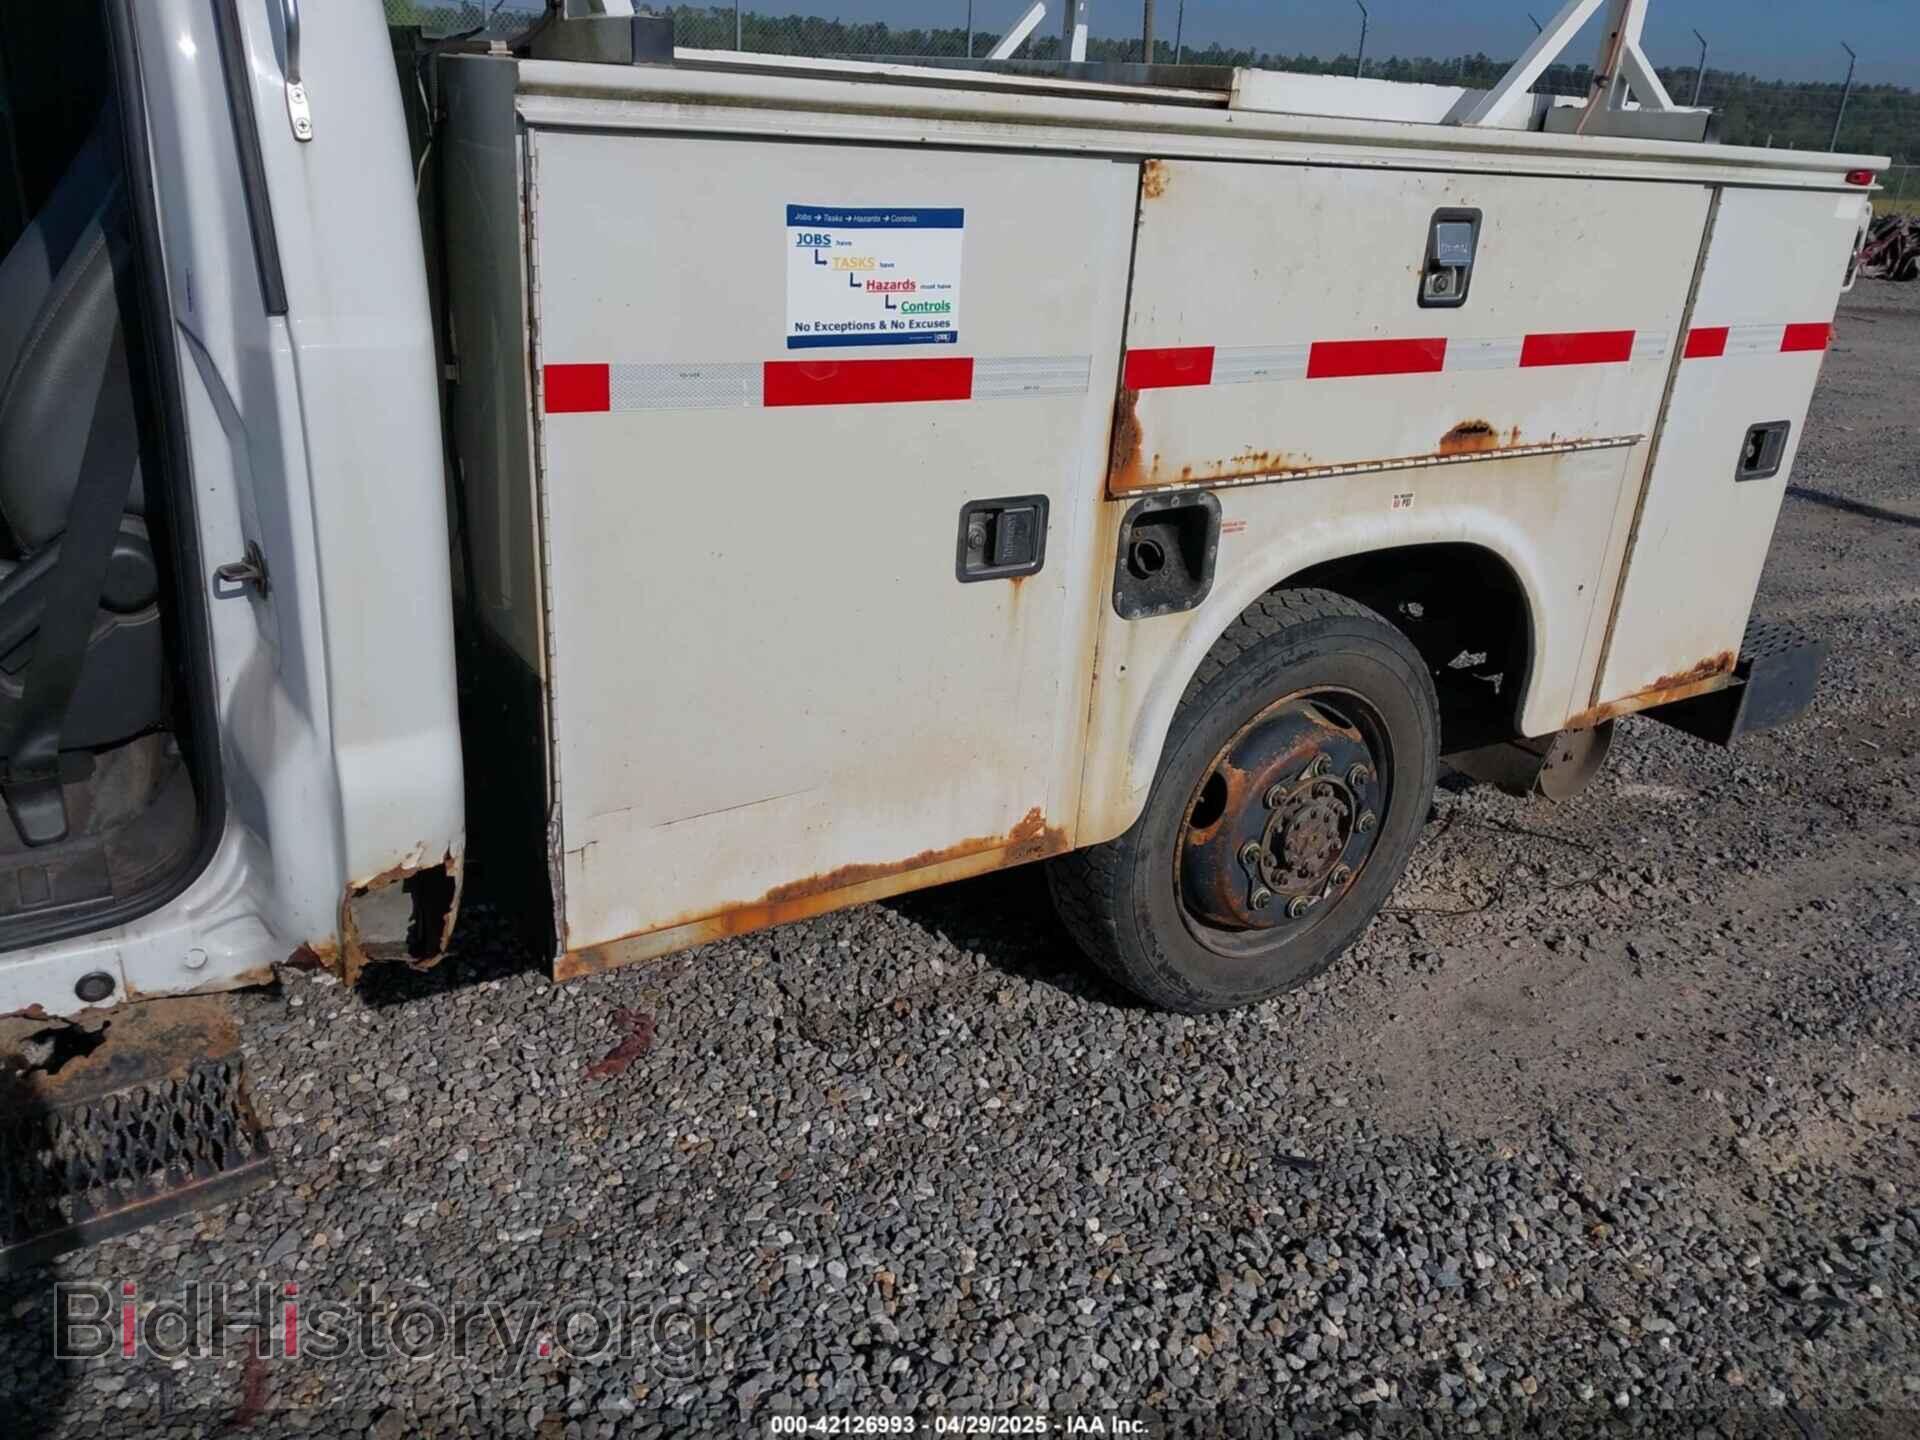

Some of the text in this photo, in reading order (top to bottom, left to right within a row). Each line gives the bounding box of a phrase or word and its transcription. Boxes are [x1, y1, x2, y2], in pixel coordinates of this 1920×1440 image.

[794, 212, 917, 223] Jobs Tasks Hazards Controls
[796, 233, 831, 246] JOBS
[832, 256, 875, 269] TASKS
[866, 278, 916, 291] Hazards
[901, 300, 951, 313] Controls
[795, 318, 950, 333] No Exceptions & No Excuses
